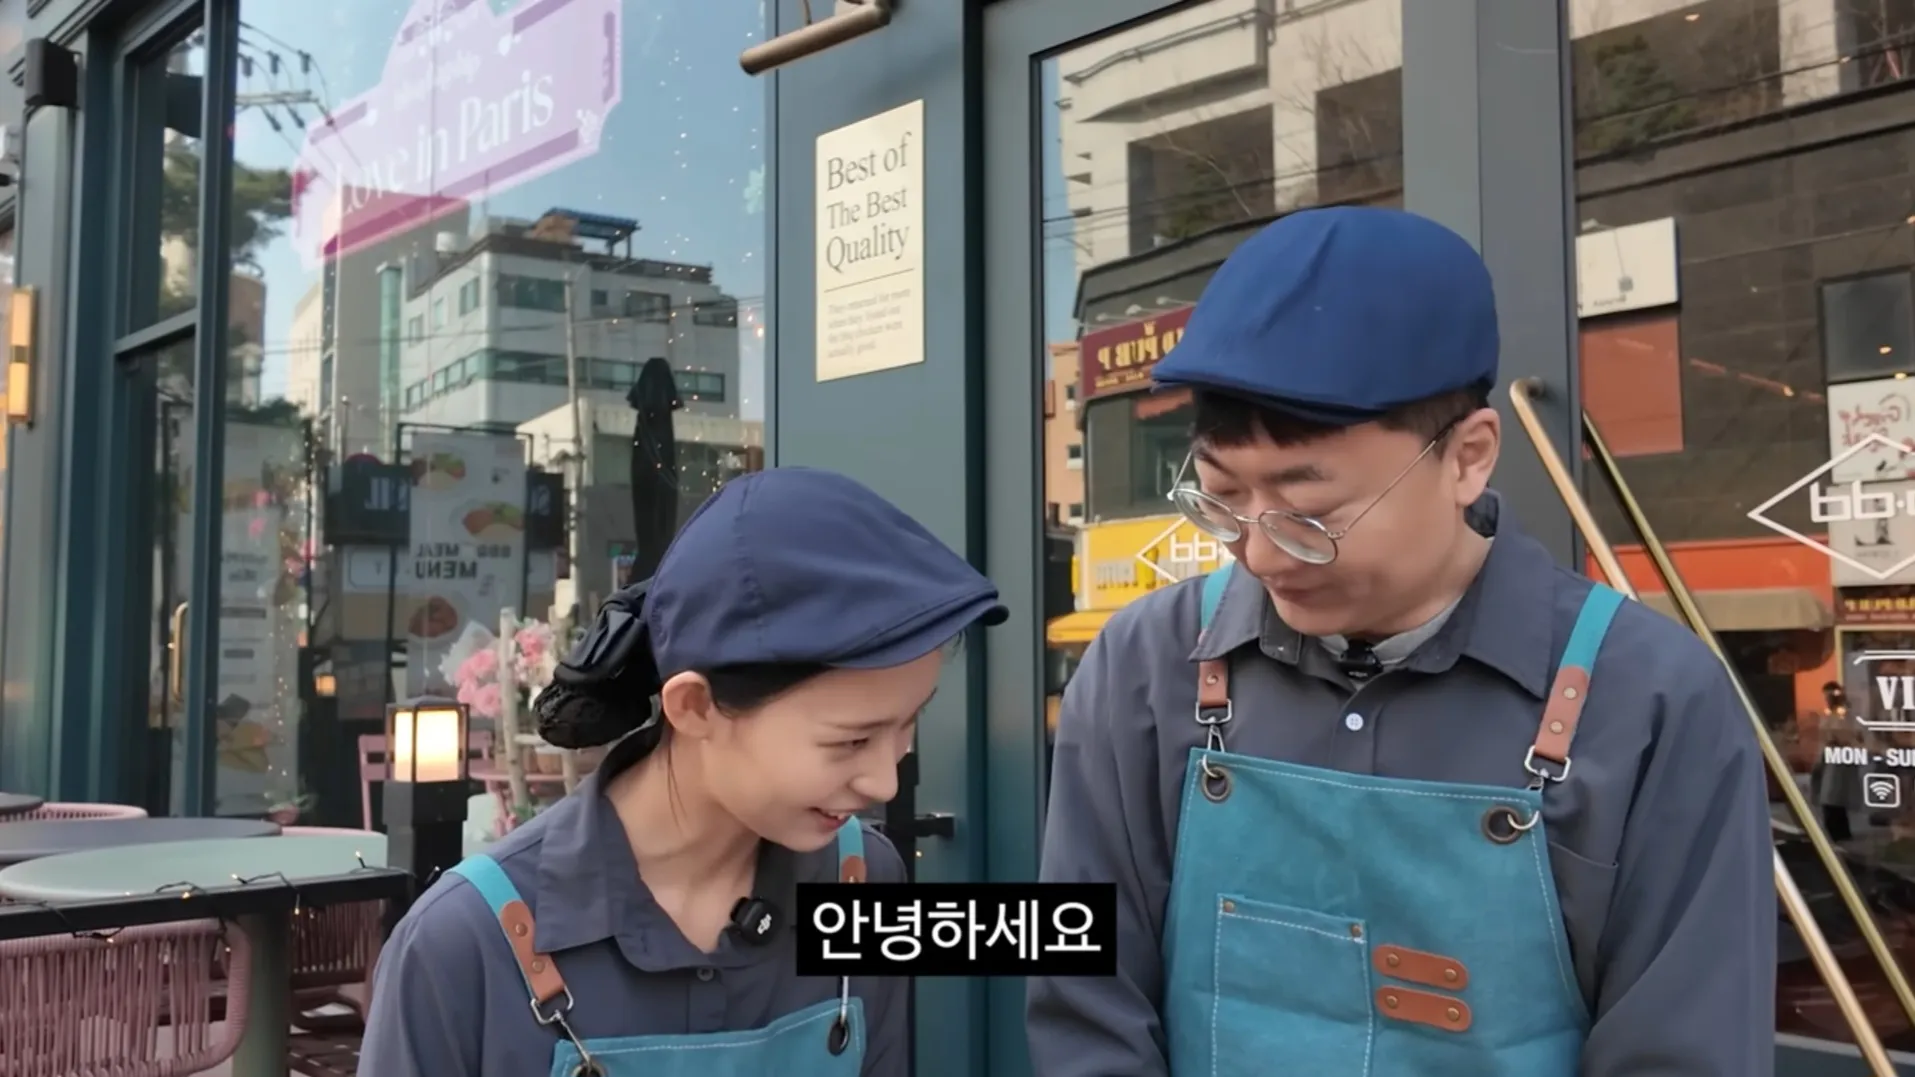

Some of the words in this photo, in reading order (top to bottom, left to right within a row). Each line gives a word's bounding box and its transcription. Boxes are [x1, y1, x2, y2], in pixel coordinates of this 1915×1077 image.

[334, 147, 411, 215] Love
[415, 123, 449, 185] in
[458, 68, 555, 163] Paris
[827, 150, 876, 192] Best
[883, 131, 912, 173] of
[826, 200, 861, 230] The
[866, 187, 907, 220] Best
[826, 222, 910, 275] Quality
[1824, 746, 1868, 765] MON
[1885, 747, 1915, 768] SU
